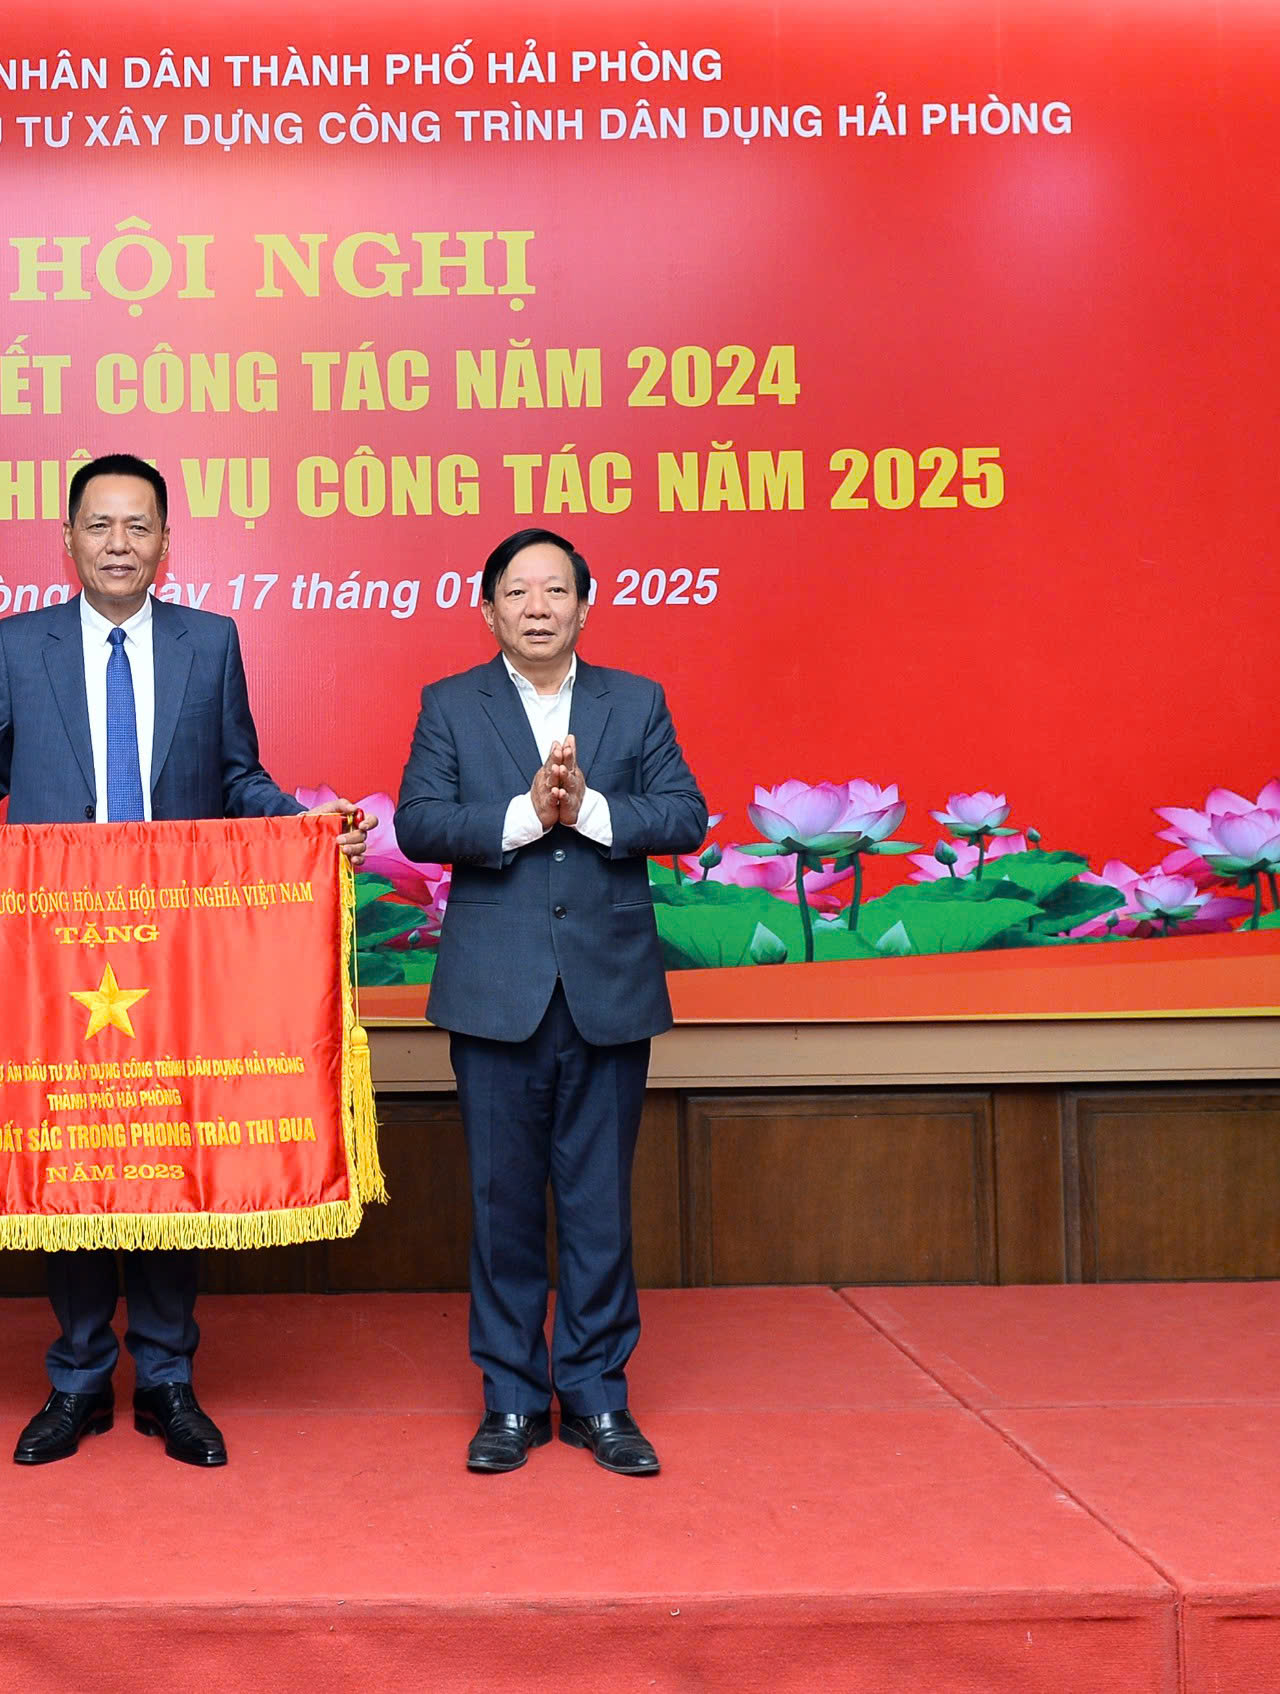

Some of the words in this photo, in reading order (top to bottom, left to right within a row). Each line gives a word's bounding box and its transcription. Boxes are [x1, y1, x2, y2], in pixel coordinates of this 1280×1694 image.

[124, 47, 210, 89] DÂN
[223, 46, 369, 87] THÀNH
[386, 38, 474, 85] PHỐ
[488, 38, 556, 84] HẢI
[572, 41, 722, 83] PHÒNG
[15, 111, 74, 149] TƯ
[84, 106, 168, 149] XÂY
[183, 108, 303, 152] DỰNG
[318, 103, 441, 145] CÔNG
[455, 101, 583, 142] TRÌNH
[600, 98, 686, 140] DÂN
[703, 105, 822, 145] DỤNG
[838, 92, 907, 137] HẢI
[922, 93, 1072, 136] PHÒNG
[10, 215, 217, 317] HỘI
[255, 231, 537, 311] NGHỊ
[96, 343, 279, 414] CÔNG
[301, 341, 430, 412] TÁC
[455, 338, 602, 409] NĂM
[627, 344, 801, 407] 2024
[180, 457, 271, 529] VỤ
[296, 445, 480, 518] CÔNG
[503, 443, 632, 514] TÁC
[657, 440, 805, 512] NĂM
[829, 447, 1004, 510] 2025
[227, 573, 279, 610] 17
[291, 570, 420, 619] tháng
[435, 571, 483, 609] 01
[612, 568, 720, 606] 2025
[29, 886, 70, 918] CỘNG
[106, 886, 126, 911] XÃ
[128, 883, 155, 915] HỘI
[159, 880, 190, 909] CHỦ
[193, 881, 240, 908] NGHĨA
[242, 879, 277, 910] VIỆT
[279, 881, 314, 903] NAM
[55, 922, 160, 948] TẶNG
[7, 1060, 22, 1082] ÁN
[64, 1060, 87, 1081] XÂY
[122, 1057, 152, 1079] CÔNG
[154, 1055, 186, 1077] TRÌNH
[212, 1058, 244, 1082] DỤNG
[244, 1050, 266, 1075] HẢI
[267, 1052, 304, 1075] PHÒNG
[47, 1088, 88, 1111] THÀNH
[90, 1085, 114, 1109] PHỐ
[116, 1085, 137, 1108] HẢI
[140, 1084, 182, 1106] PHÒNG
[27, 1119, 63, 1152] SẮC
[67, 1123, 127, 1149] TRONG
[130, 1121, 192, 1147] PHONG
[194, 1116, 241, 1146] TRÀO
[245, 1119, 275, 1144] THI
[278, 1118, 316, 1142] ĐUA
[46, 1162, 116, 1183] NĂM
[123, 1164, 184, 1180] 2023
